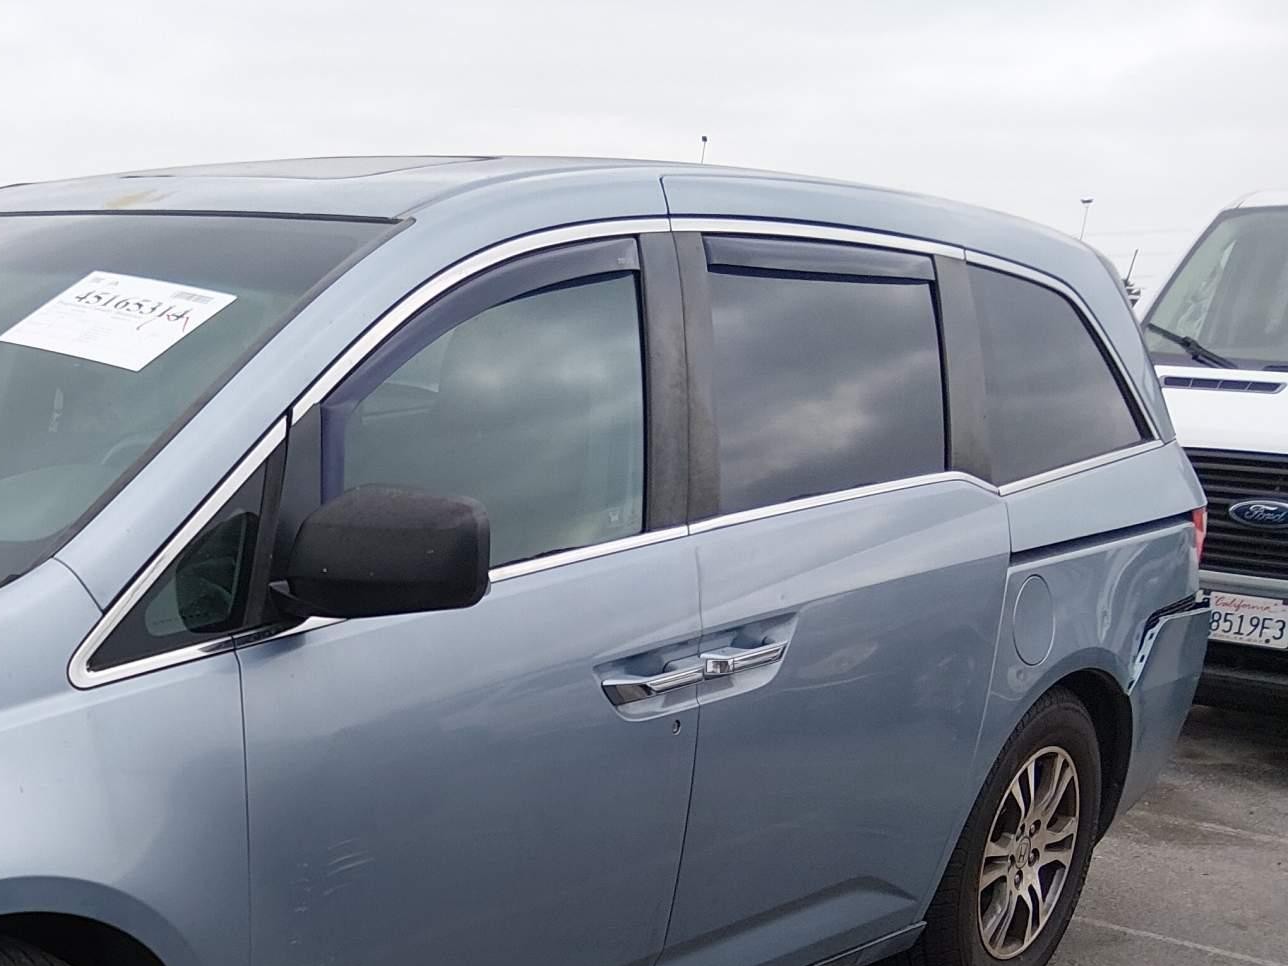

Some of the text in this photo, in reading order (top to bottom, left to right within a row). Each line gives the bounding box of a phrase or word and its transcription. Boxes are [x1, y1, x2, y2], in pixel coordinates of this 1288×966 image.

[74, 290, 192, 322] 45165314
[1244, 504, 1287, 522] Ford
[1215, 596, 1271, 611] California
[1210, 611, 1286, 640] 8519F3
